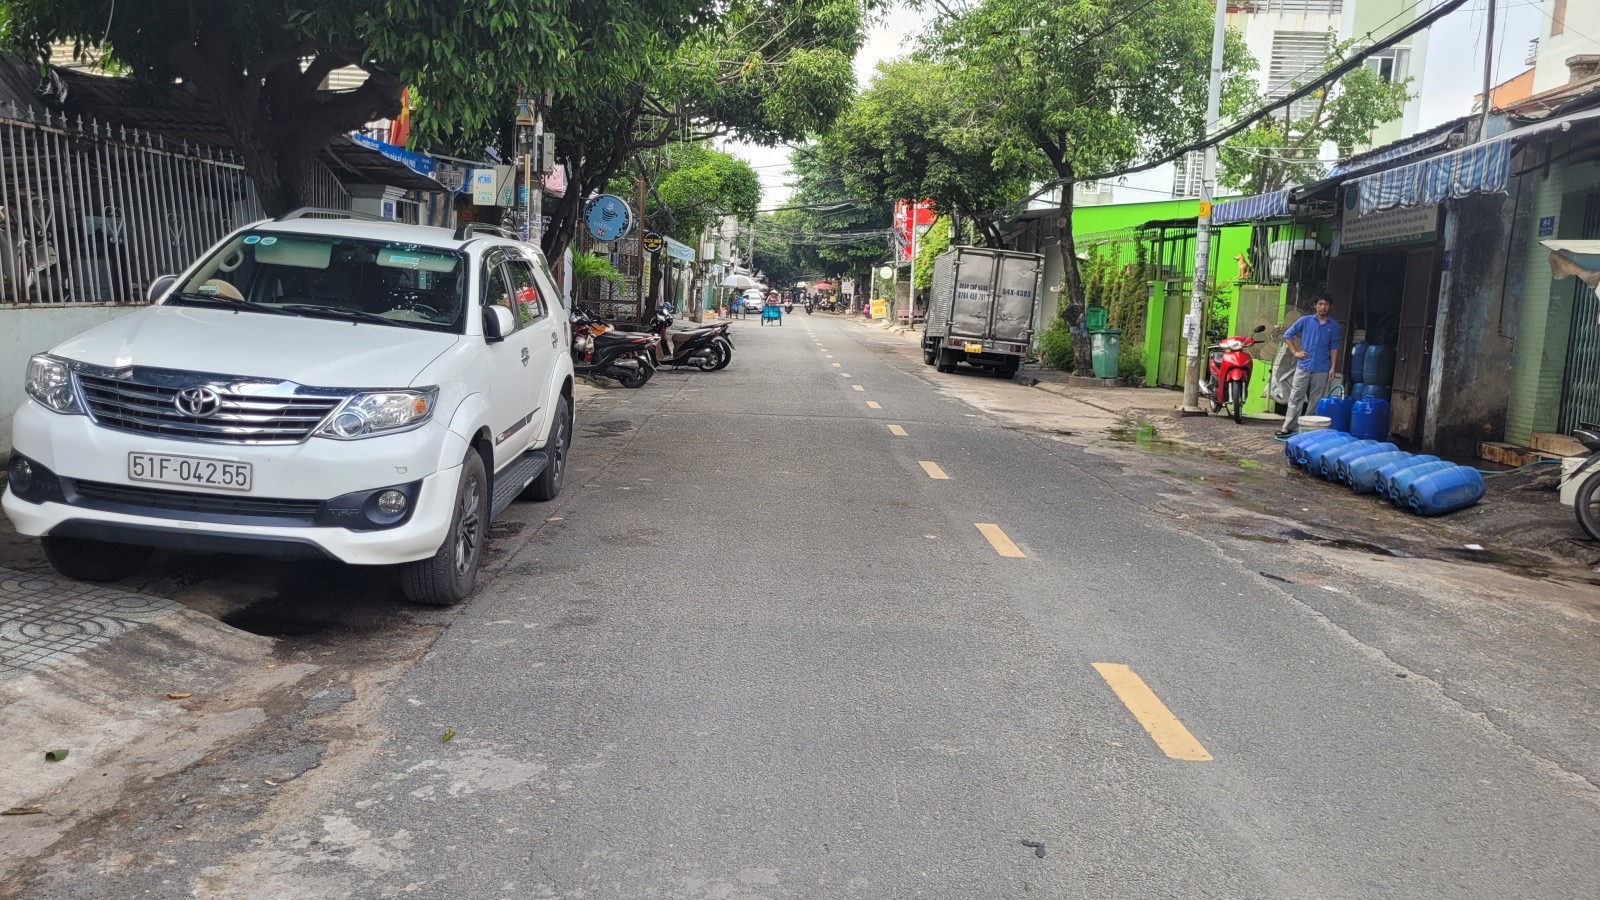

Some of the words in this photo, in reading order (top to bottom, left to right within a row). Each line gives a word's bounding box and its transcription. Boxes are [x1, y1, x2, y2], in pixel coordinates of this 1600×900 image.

[593, 221, 613, 231] coffee
[1543, 218, 1551, 226] 84
[133, 455, 248, 487] 51F-042.55
